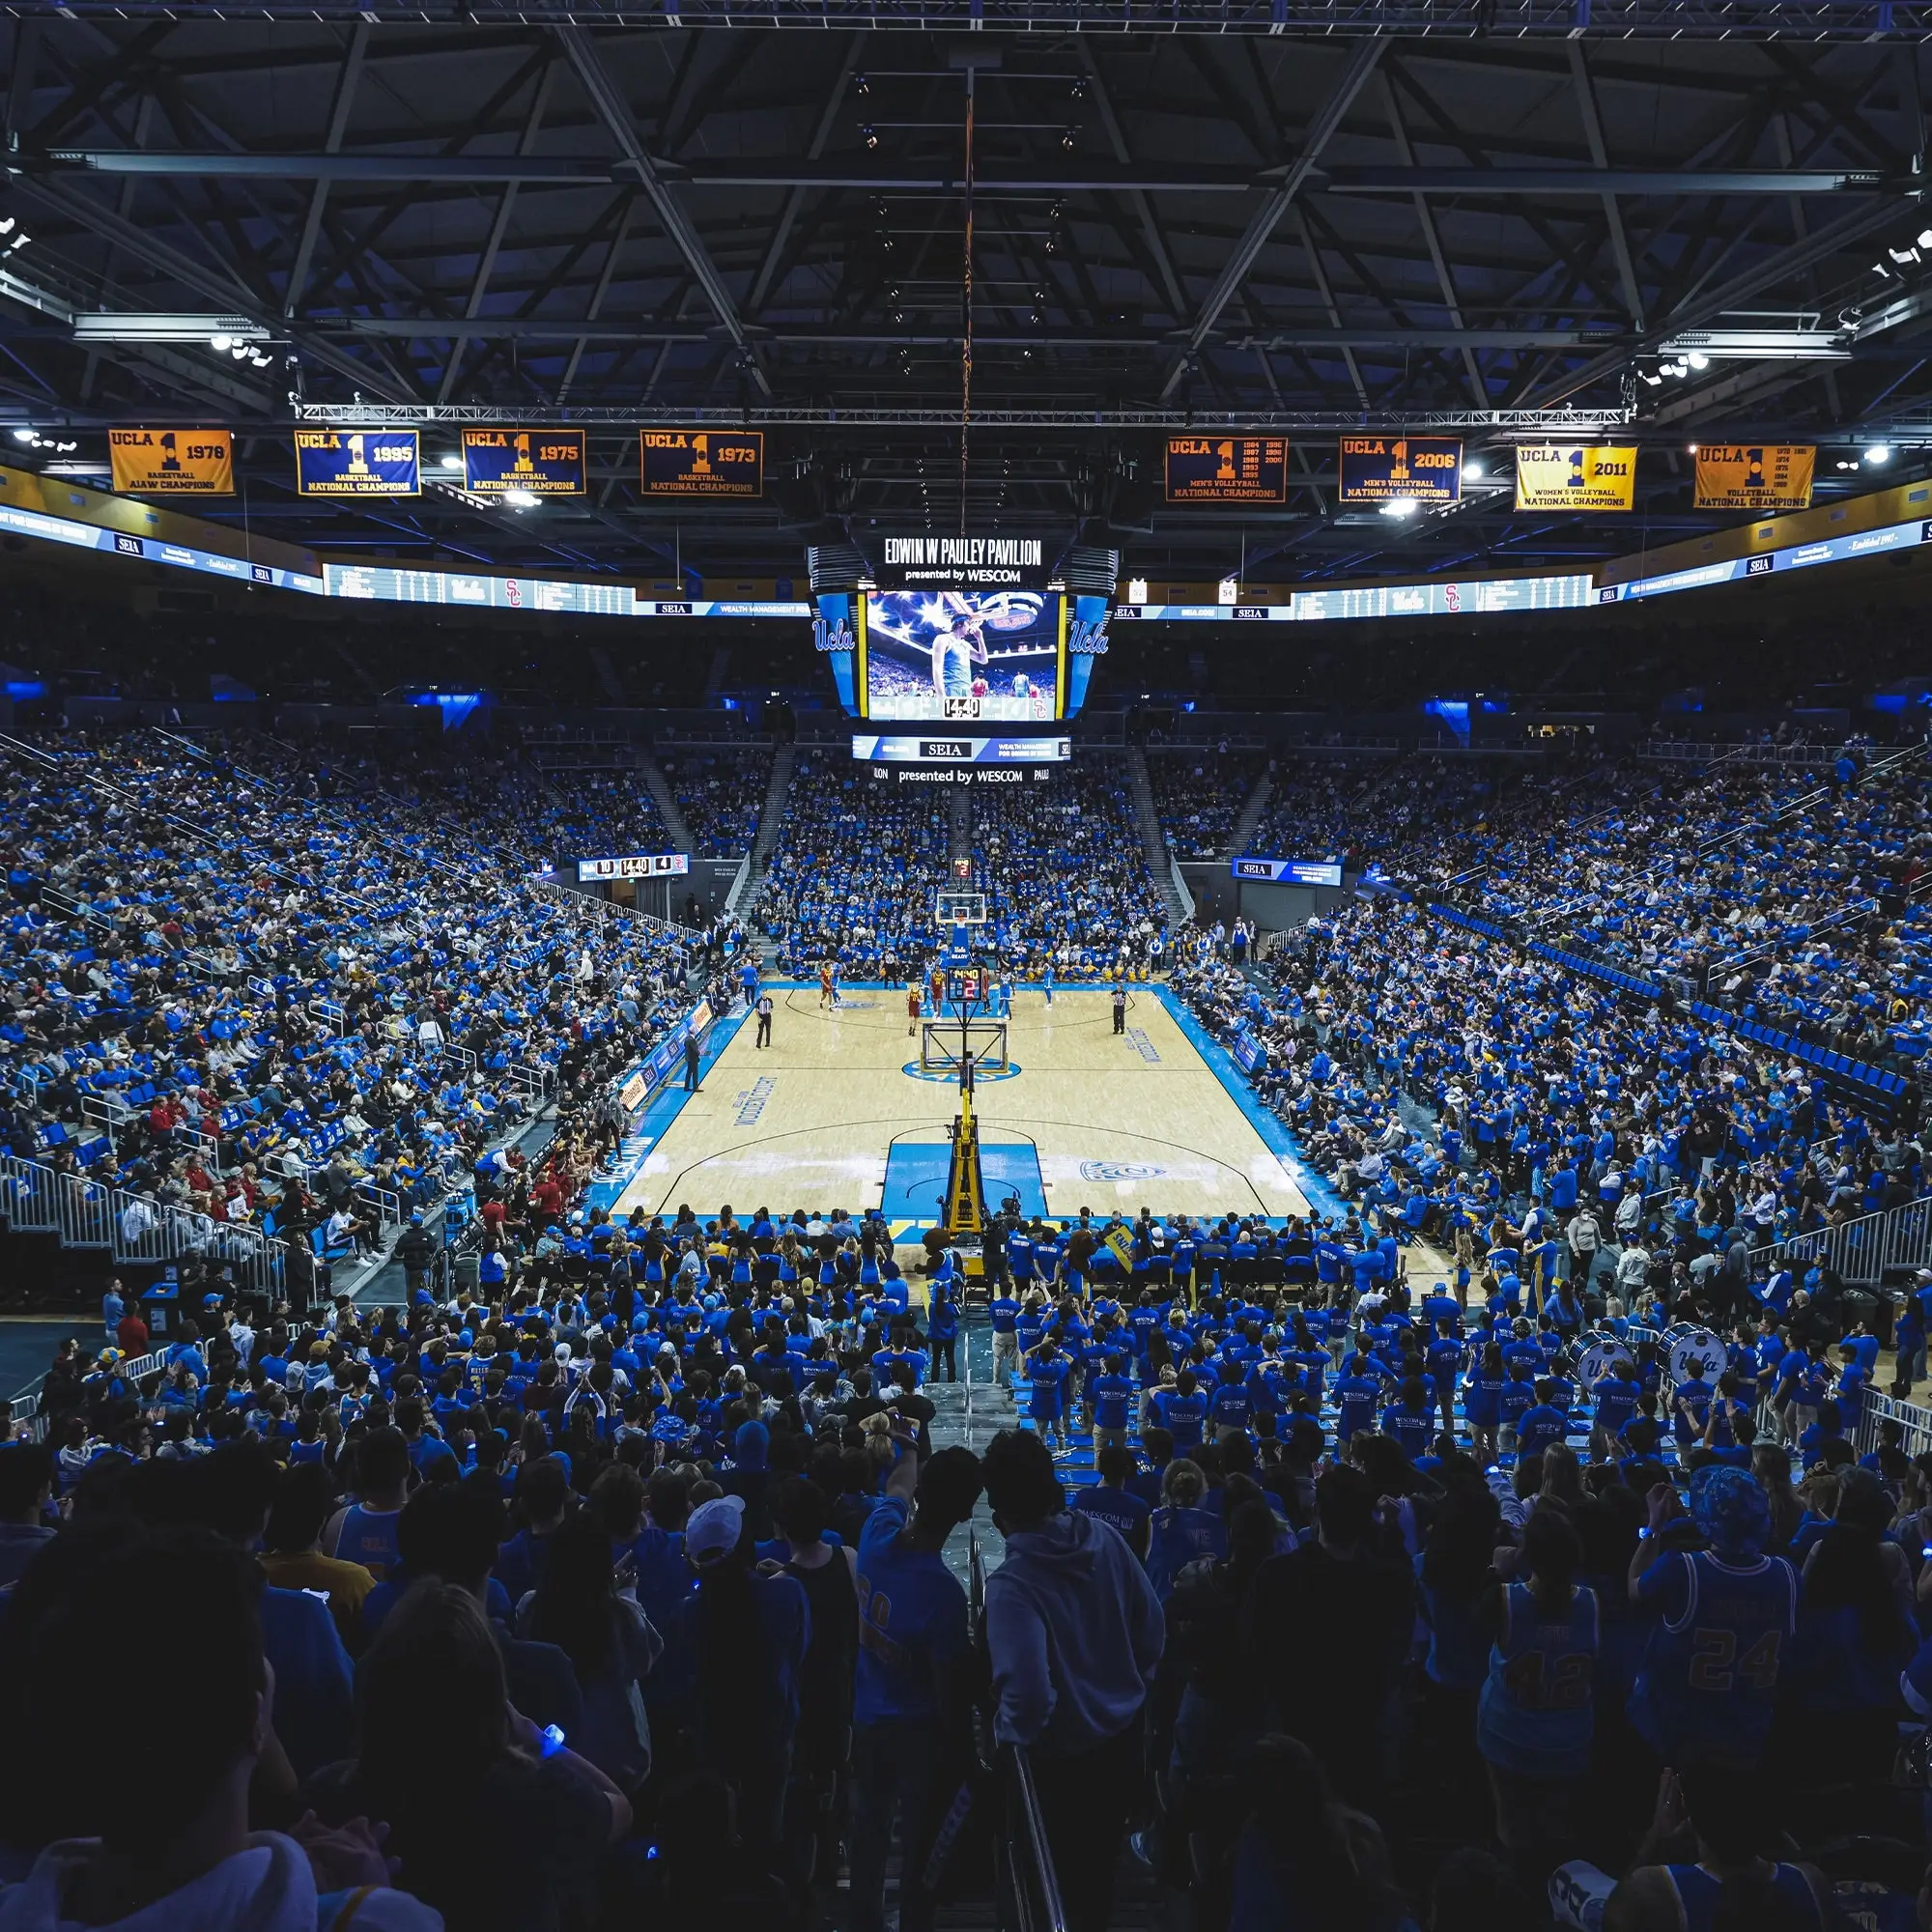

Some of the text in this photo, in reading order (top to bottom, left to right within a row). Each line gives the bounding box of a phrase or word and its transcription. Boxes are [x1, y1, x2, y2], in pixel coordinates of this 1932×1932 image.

[111, 432, 154, 446] UCLA
[299, 435, 341, 449] UCLA
[466, 433, 507, 447] UCLA
[645, 434, 688, 448] UCLA
[159, 433, 180, 470] 1
[186, 446, 224, 460] 1978
[347, 434, 369, 473] 1
[514, 434, 533, 472] 1
[539, 446, 579, 460] 1975
[692, 435, 711, 473] 1
[1169, 440, 1211, 454] UCLA
[1344, 440, 1385, 454] UCLA
[373, 447, 413, 462] 1995
[718, 447, 755, 463] 1973
[1217, 441, 1236, 479] 1
[1390, 441, 1409, 479] 1
[1414, 453, 1456, 469] 2006
[1520, 450, 1562, 463] UCLA
[1700, 448, 1744, 462] UCLA
[1568, 450, 1585, 487] 1
[1595, 463, 1628, 476] 2011
[1745, 448, 1765, 487] 1
[334, 473, 382, 482] BASKETBALL
[129, 480, 215, 490] AIAW CHAMPIONS
[308, 482, 411, 492] NATIONAL CHAMPIONS
[473, 481, 576, 490] NATIONAL CHAMPIONS
[650, 481, 753, 493] NATIONAL CHAMPIONS
[1348, 487, 1450, 497] NATIONAL CHAMPIONS
[1224, 489, 1276, 497] CHAMPIONS
[1534, 488, 1569, 497] WOMEN'S
[1524, 497, 1625, 506] NATIONAL CHAMPIONS
[1698, 497, 1805, 506] NATIONAL CHAMPIONS
[119, 539, 139, 554] SEIA
[885, 538, 1041, 566] EDWIN W PAULEY PAVILION
[1749, 557, 1769, 573] SEIA
[254, 568, 270, 581] SEIA
[905, 569, 1021, 582] presented by WESCOM
[1602, 589, 1615, 601] SEIA
[662, 605, 686, 613] SEIA
[1238, 609, 1262, 618] SEIA
[928, 744, 961, 756] SEIA
[899, 770, 1023, 784] presented by WESCOM
[601, 862, 611, 872] 10
[660, 858, 668, 867] 4
[1243, 865, 1265, 874] SEIA
[960, 866, 967, 875] 2
[954, 969, 979, 980] 14:40
[965, 980, 976, 998] 2
[1170, 1411, 1194, 1420] WESCOM
[1690, 1628, 1783, 1690] 24
[1505, 1650, 1595, 1710] 42
